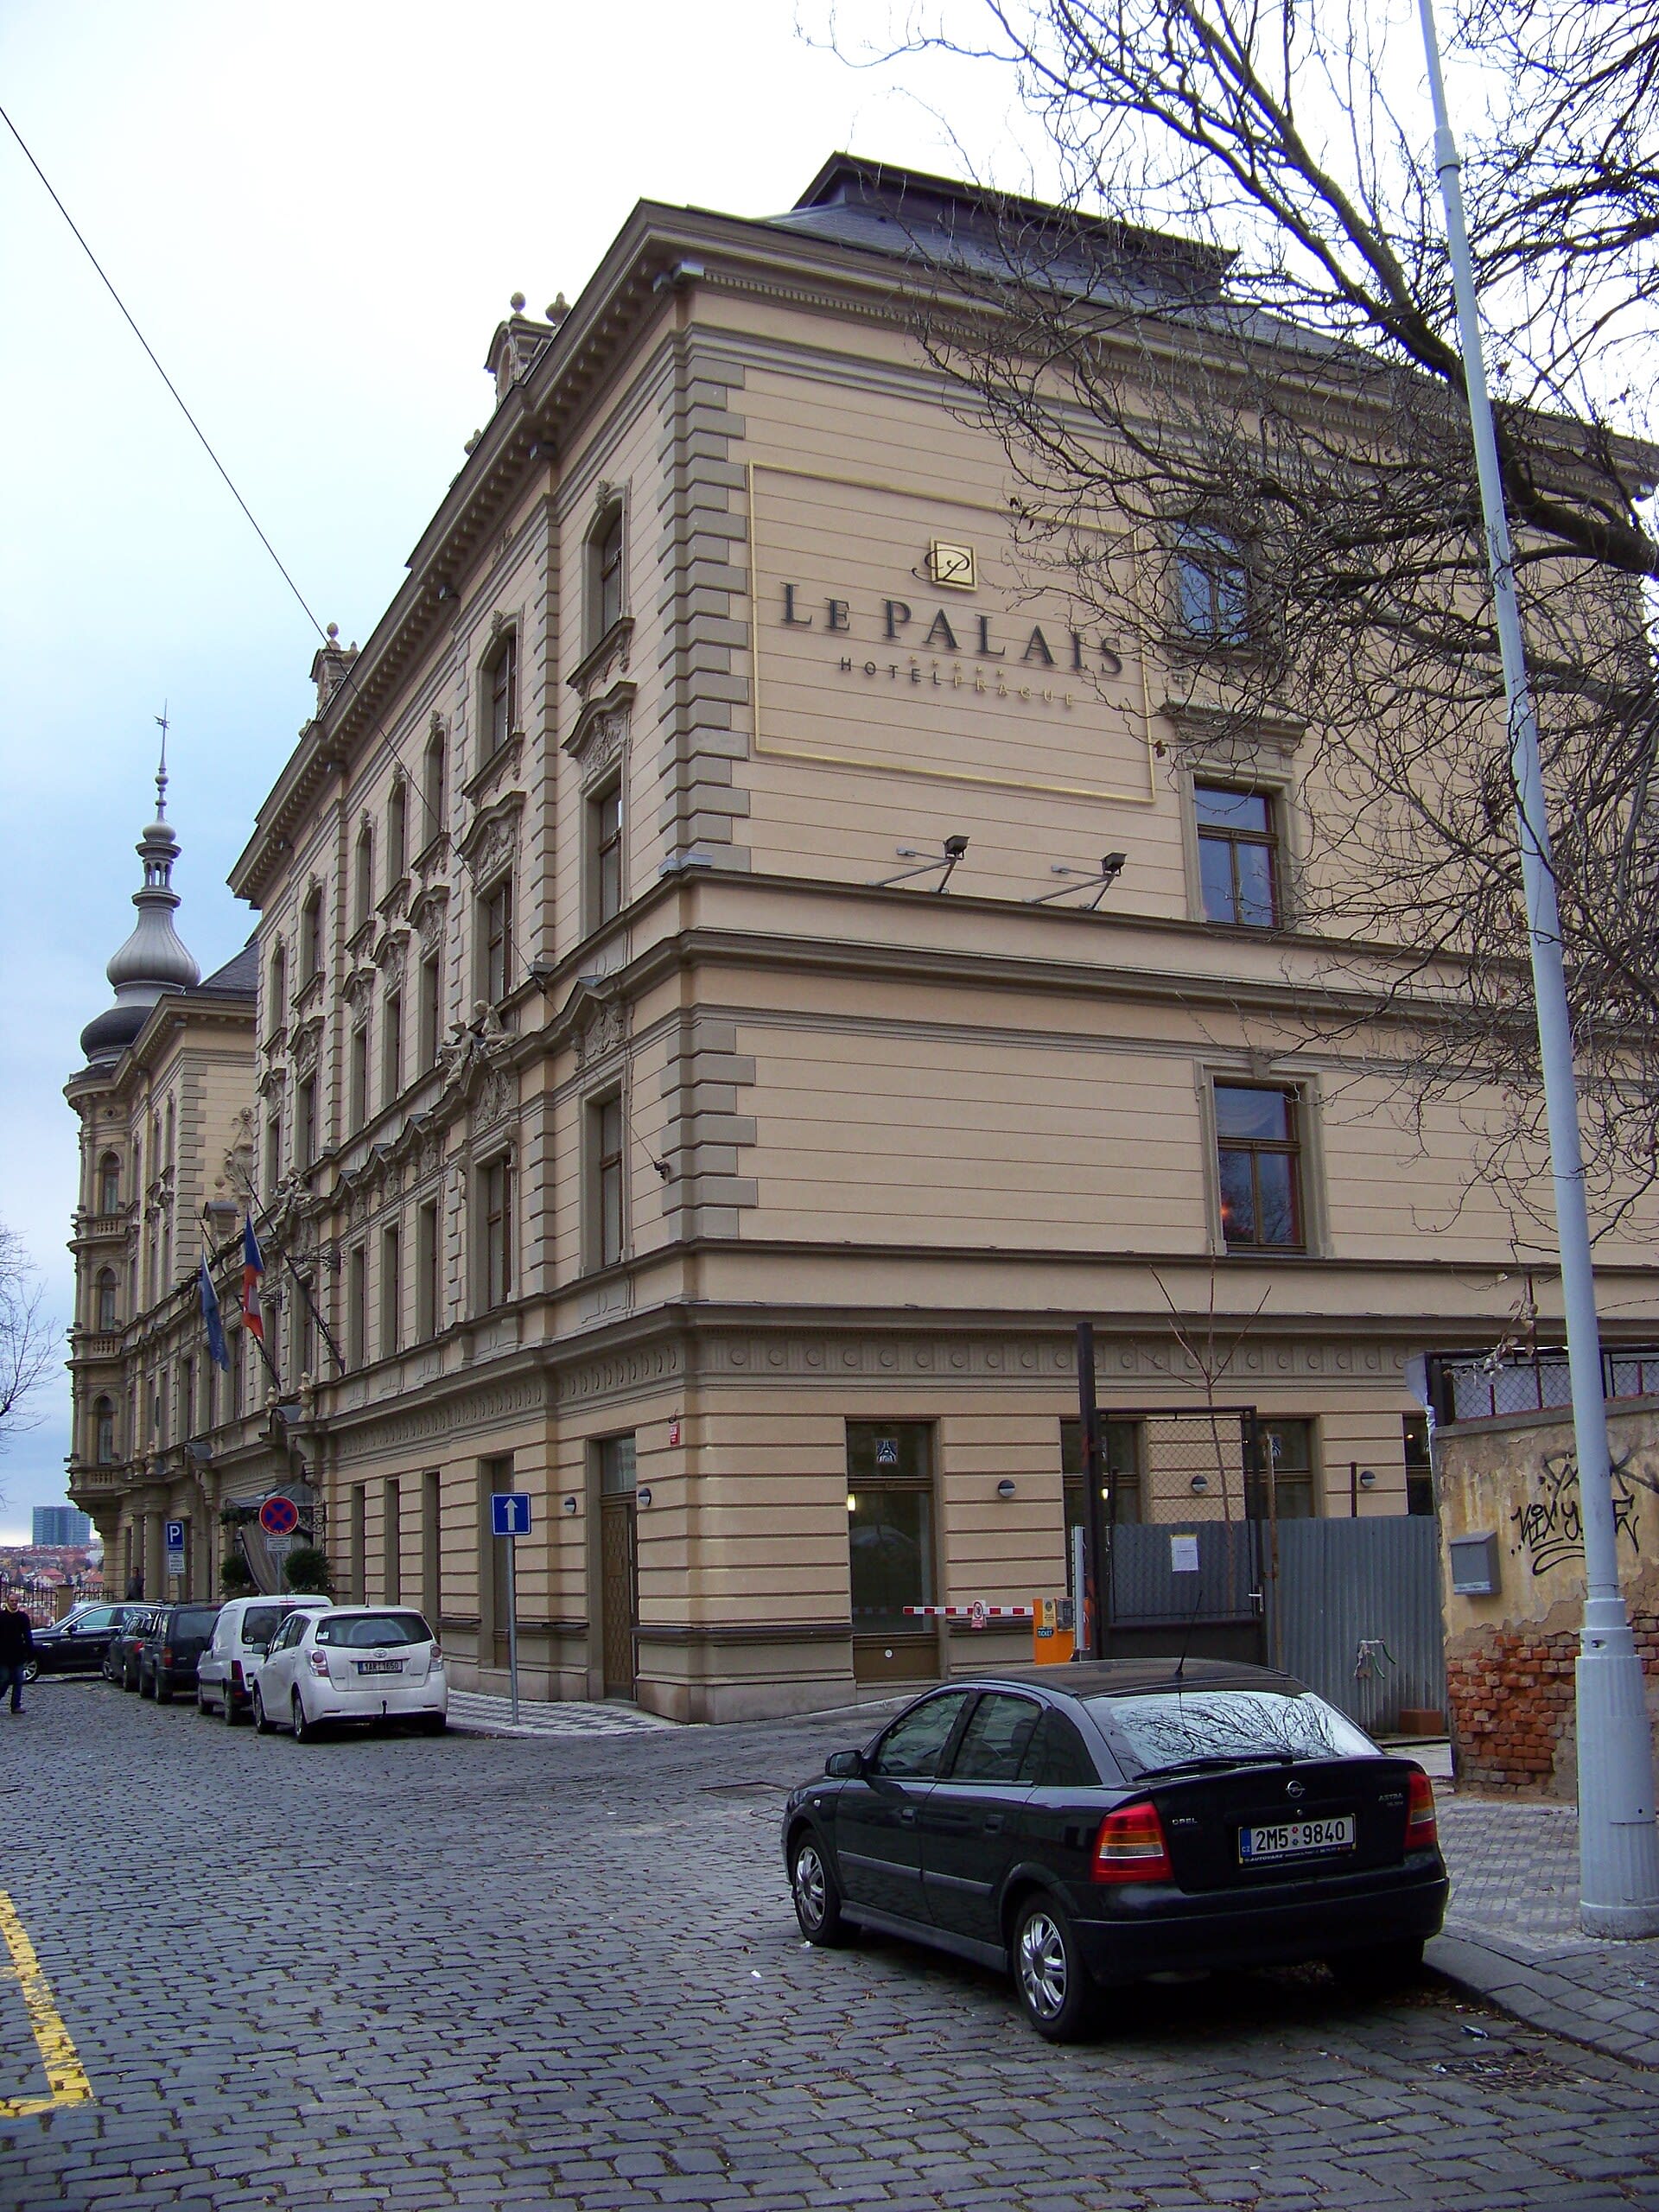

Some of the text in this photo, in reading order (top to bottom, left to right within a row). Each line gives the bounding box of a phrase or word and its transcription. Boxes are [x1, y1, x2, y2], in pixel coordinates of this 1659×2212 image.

[779, 581, 1124, 677] LE PALAIS
[840, 656, 1074, 707] HOTEL PRAGUE
[168, 1525, 181, 1542] P
[1255, 1821, 1345, 1852] 2M5 9840
